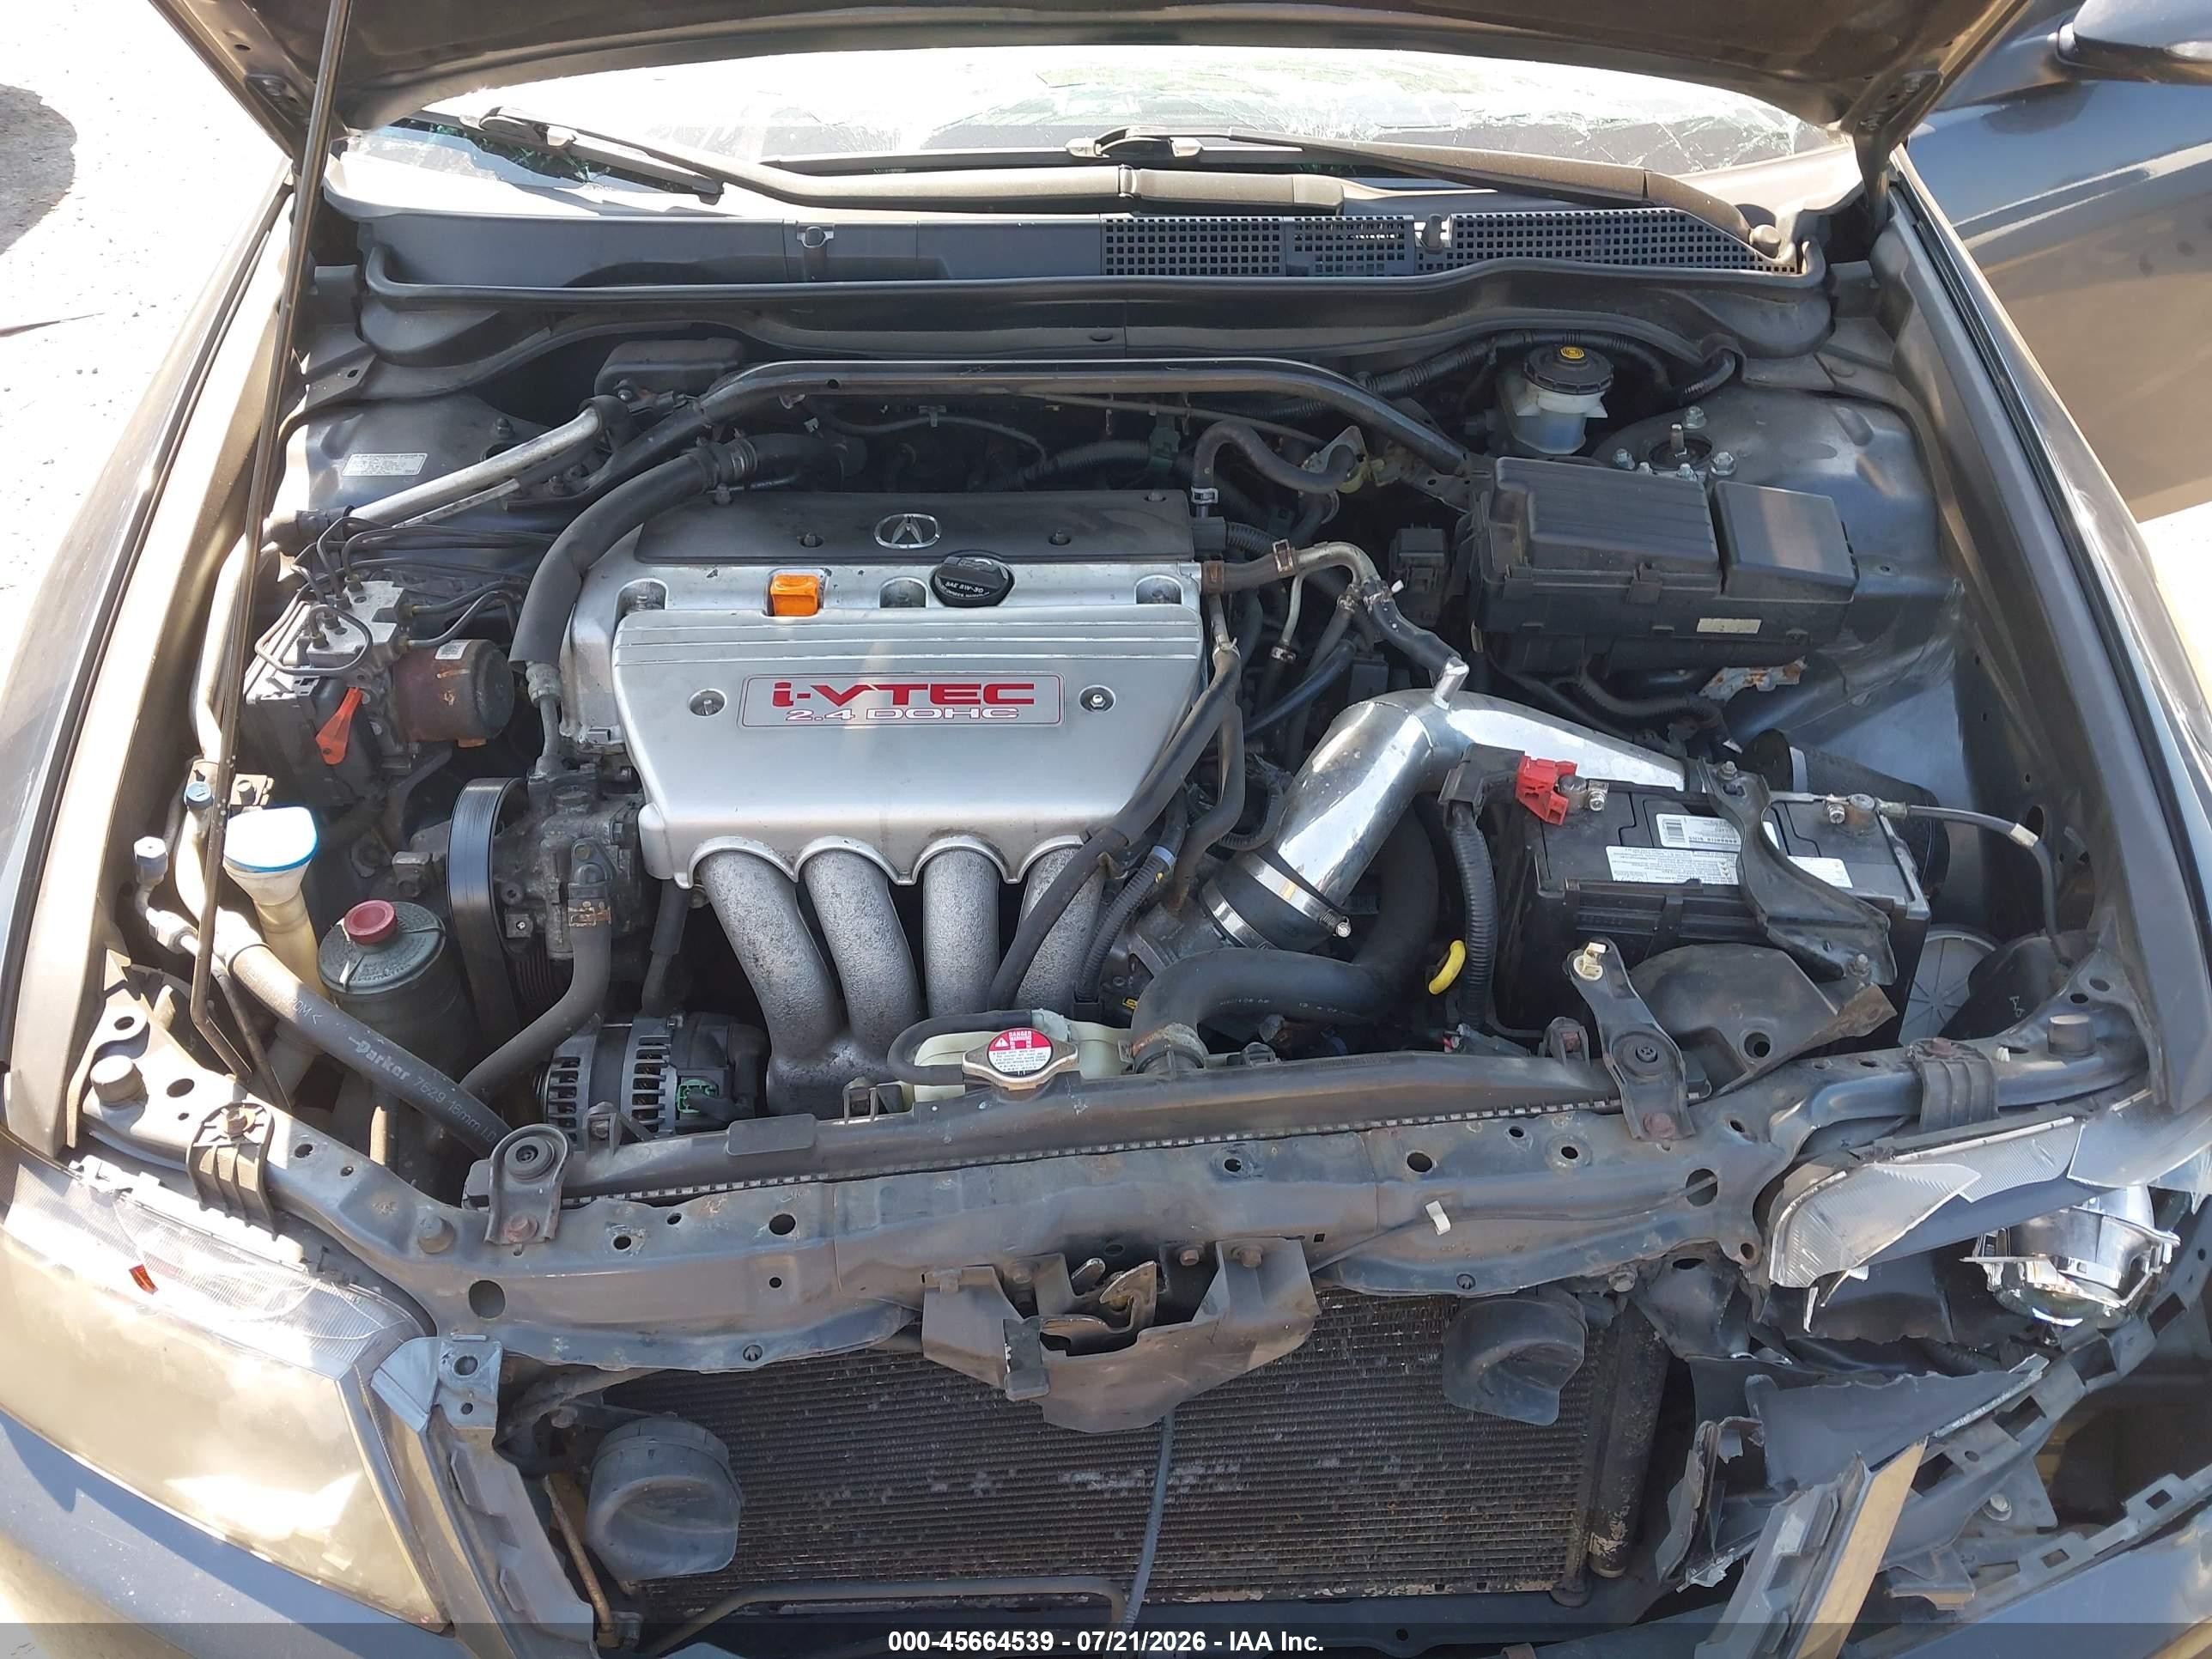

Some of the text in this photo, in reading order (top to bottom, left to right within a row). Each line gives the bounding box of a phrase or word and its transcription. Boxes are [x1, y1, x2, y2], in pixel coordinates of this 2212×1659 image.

[772, 681, 1035, 707] i-VTEC
[786, 708, 1019, 721] 2.4 DOHC
[349, 1037, 410, 1080] Parker
[414, 1077, 447, 1103] 7629
